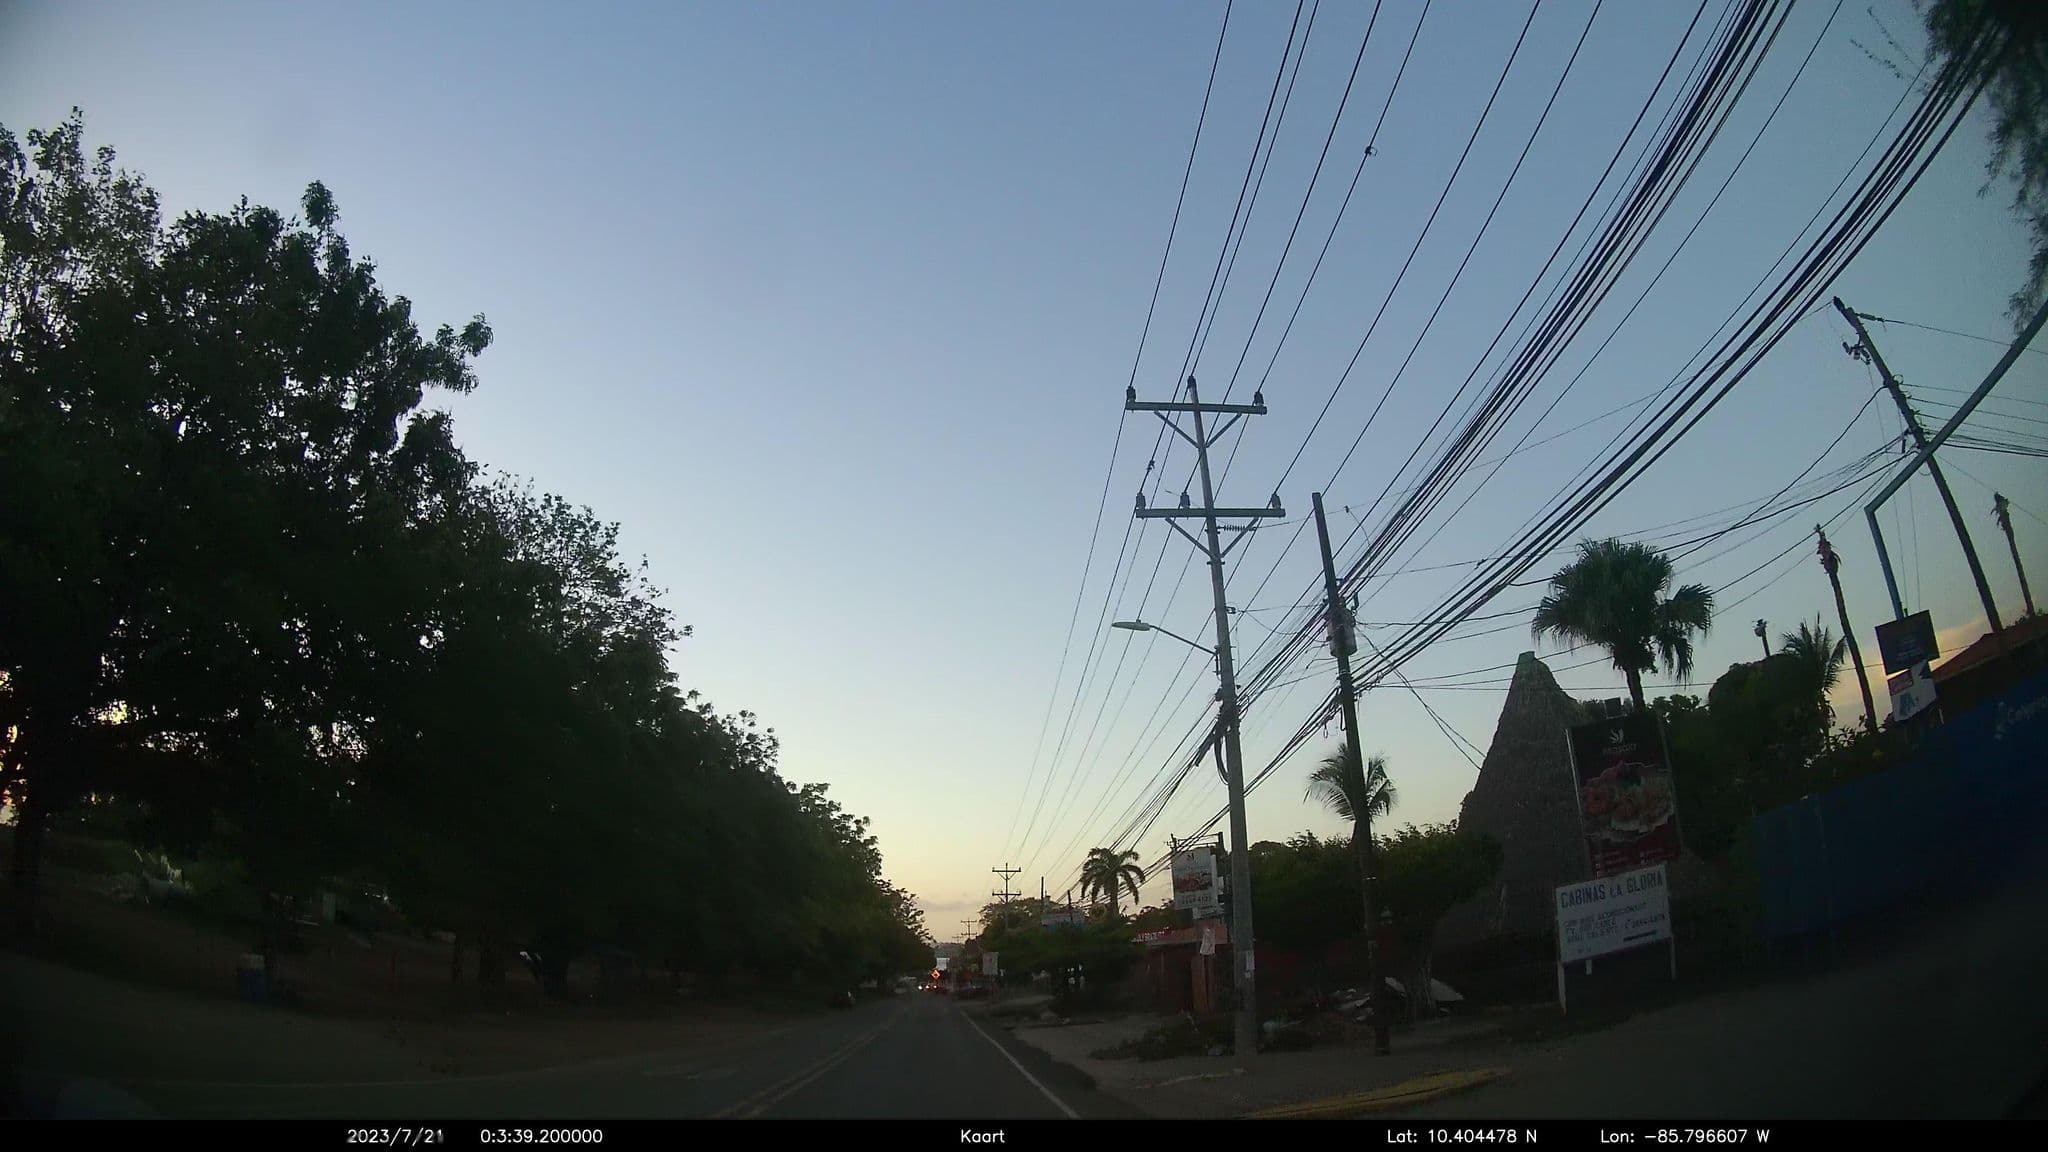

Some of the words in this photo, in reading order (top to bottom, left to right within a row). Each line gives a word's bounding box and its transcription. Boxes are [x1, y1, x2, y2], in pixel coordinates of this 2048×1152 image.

[1561, 884, 1606, 908] CABINAS
[1610, 885, 1623, 897] LA
[1626, 871, 1663, 894] GLORIA
